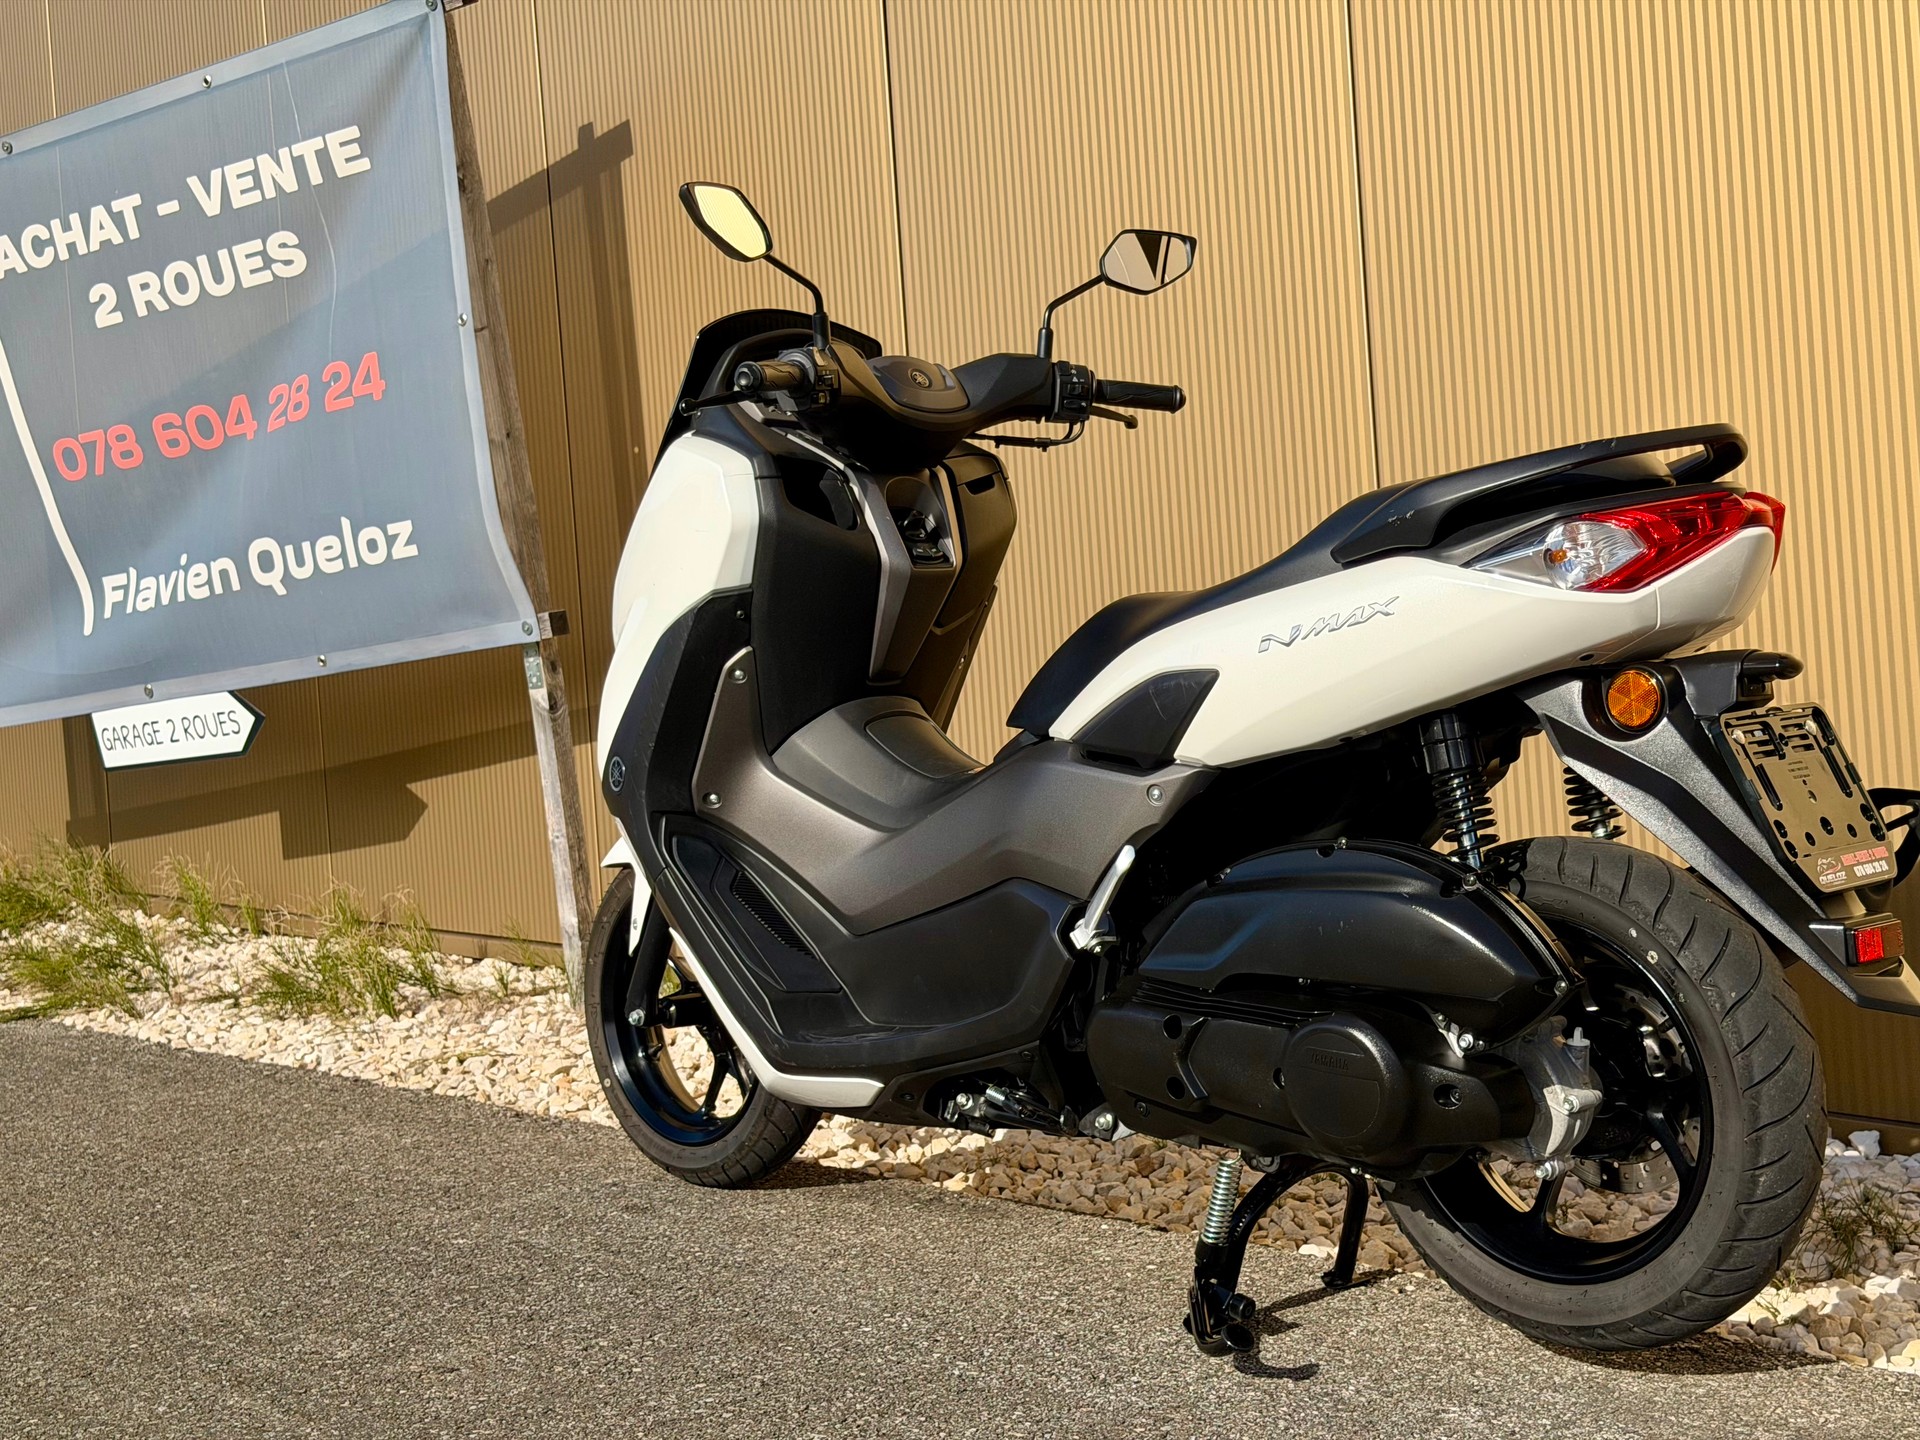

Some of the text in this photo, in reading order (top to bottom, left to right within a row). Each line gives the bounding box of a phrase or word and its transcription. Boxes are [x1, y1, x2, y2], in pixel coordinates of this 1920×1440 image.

[0, 193, 142, 280] ACHAT
[186, 125, 372, 217] VENTE
[88, 230, 308, 329] 2 ROUES
[52, 351, 386, 482] 078 604 28 24
[102, 516, 419, 619] Flavien Queloz
[1258, 595, 1400, 653] NMAX
[101, 710, 241, 751] GARAGE 2 ROUES
